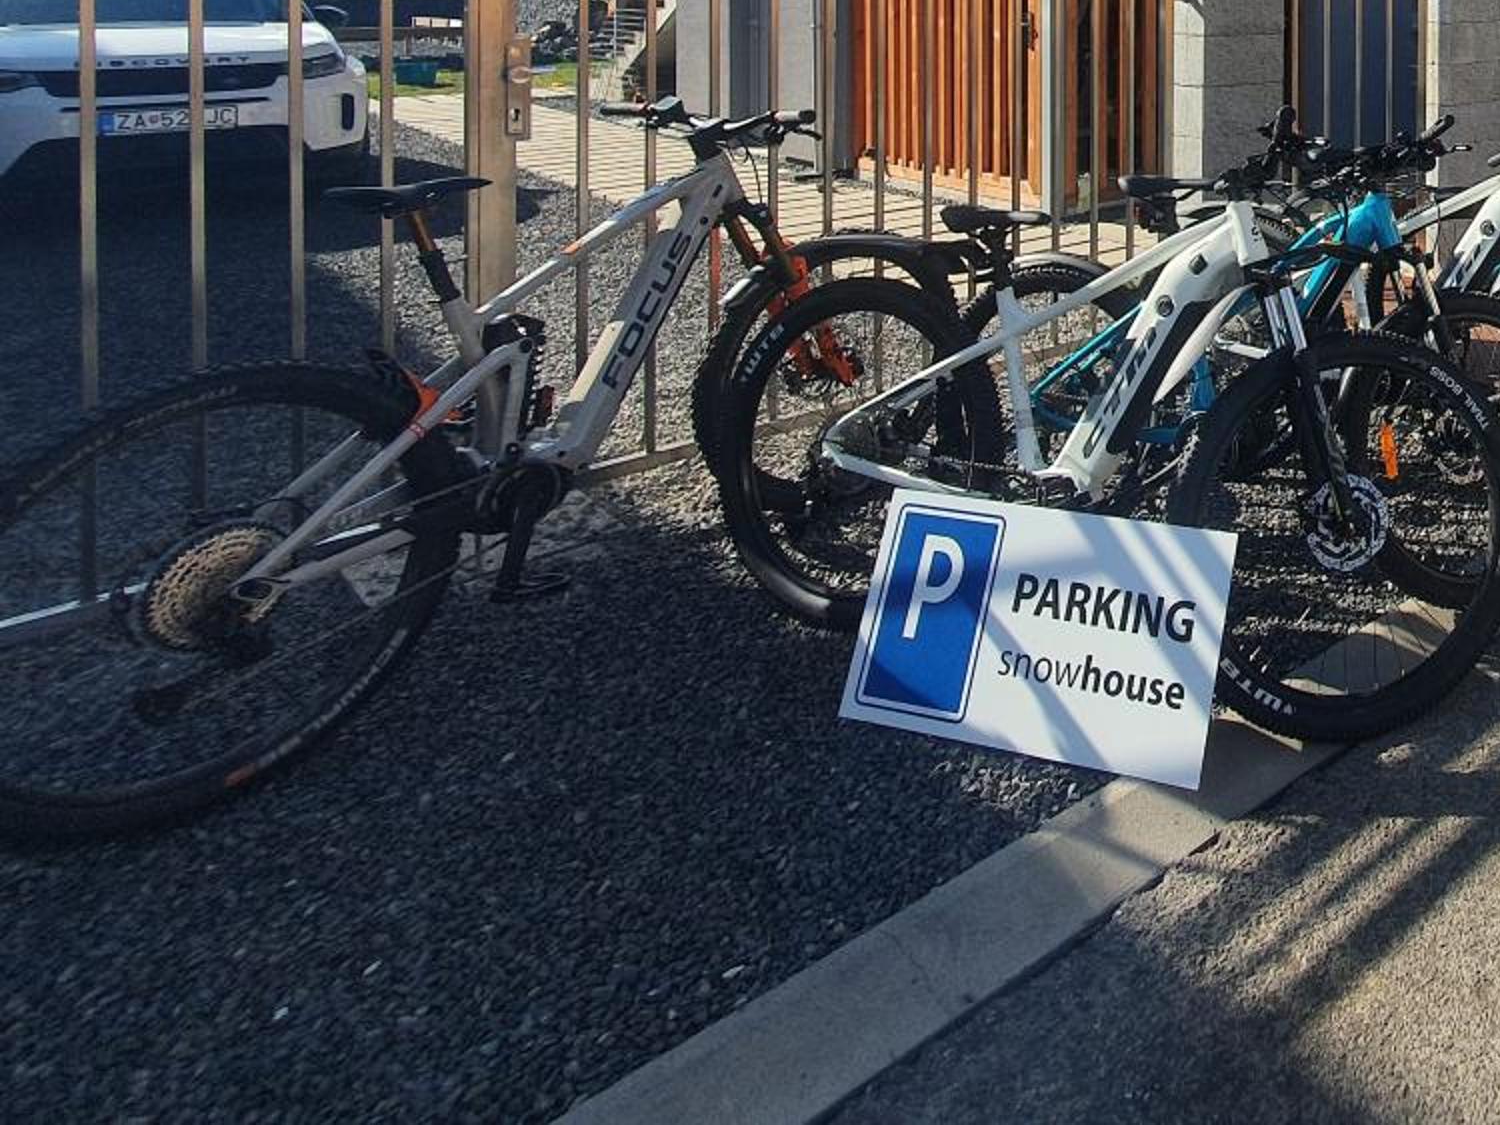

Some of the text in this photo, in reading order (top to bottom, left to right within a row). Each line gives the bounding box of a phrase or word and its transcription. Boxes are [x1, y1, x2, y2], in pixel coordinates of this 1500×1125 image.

[117, 113, 147, 130] ZA
[602, 230, 692, 390] FOCUS
[744, 324, 785, 375] WTB
[1429, 365, 1490, 430] TRAIL BOSS
[902, 533, 965, 641] P
[1011, 572, 1197, 644] PARKING
[997, 649, 1186, 710] snowhouse
[1219, 657, 1283, 712] WTB
